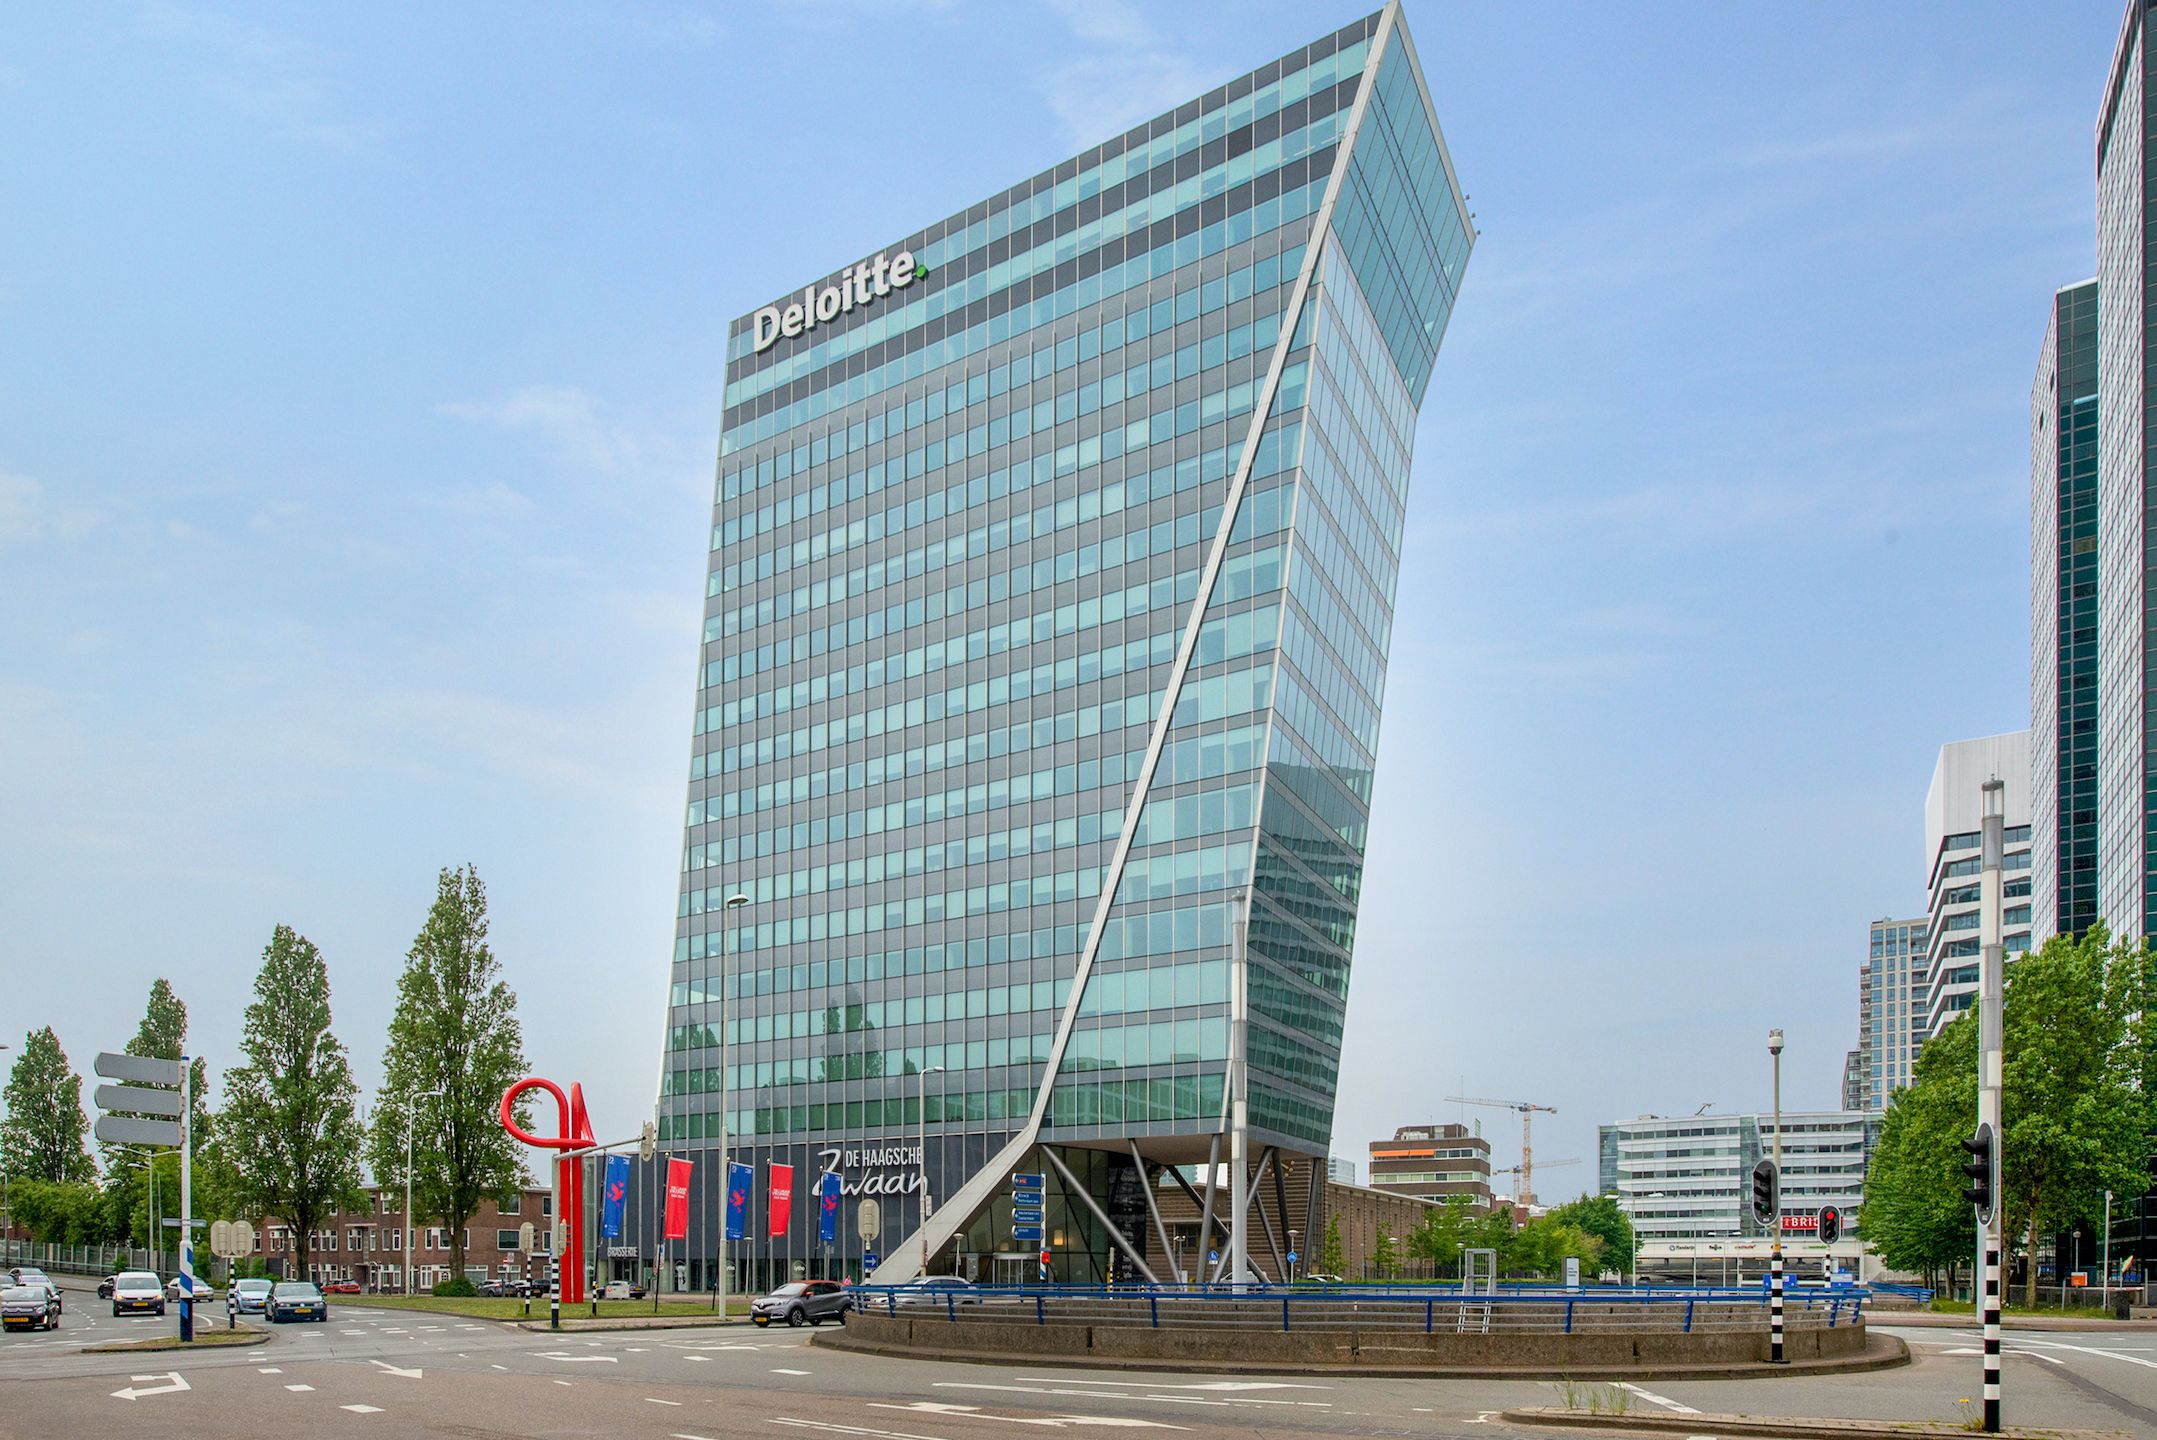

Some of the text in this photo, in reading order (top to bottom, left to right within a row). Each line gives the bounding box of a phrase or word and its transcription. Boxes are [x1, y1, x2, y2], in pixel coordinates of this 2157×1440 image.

[753, 250, 929, 352] Deloitte.
[845, 1146, 921, 1168] DE HAAGSCHE
[607, 1246, 638, 1258] BRASSERIE
